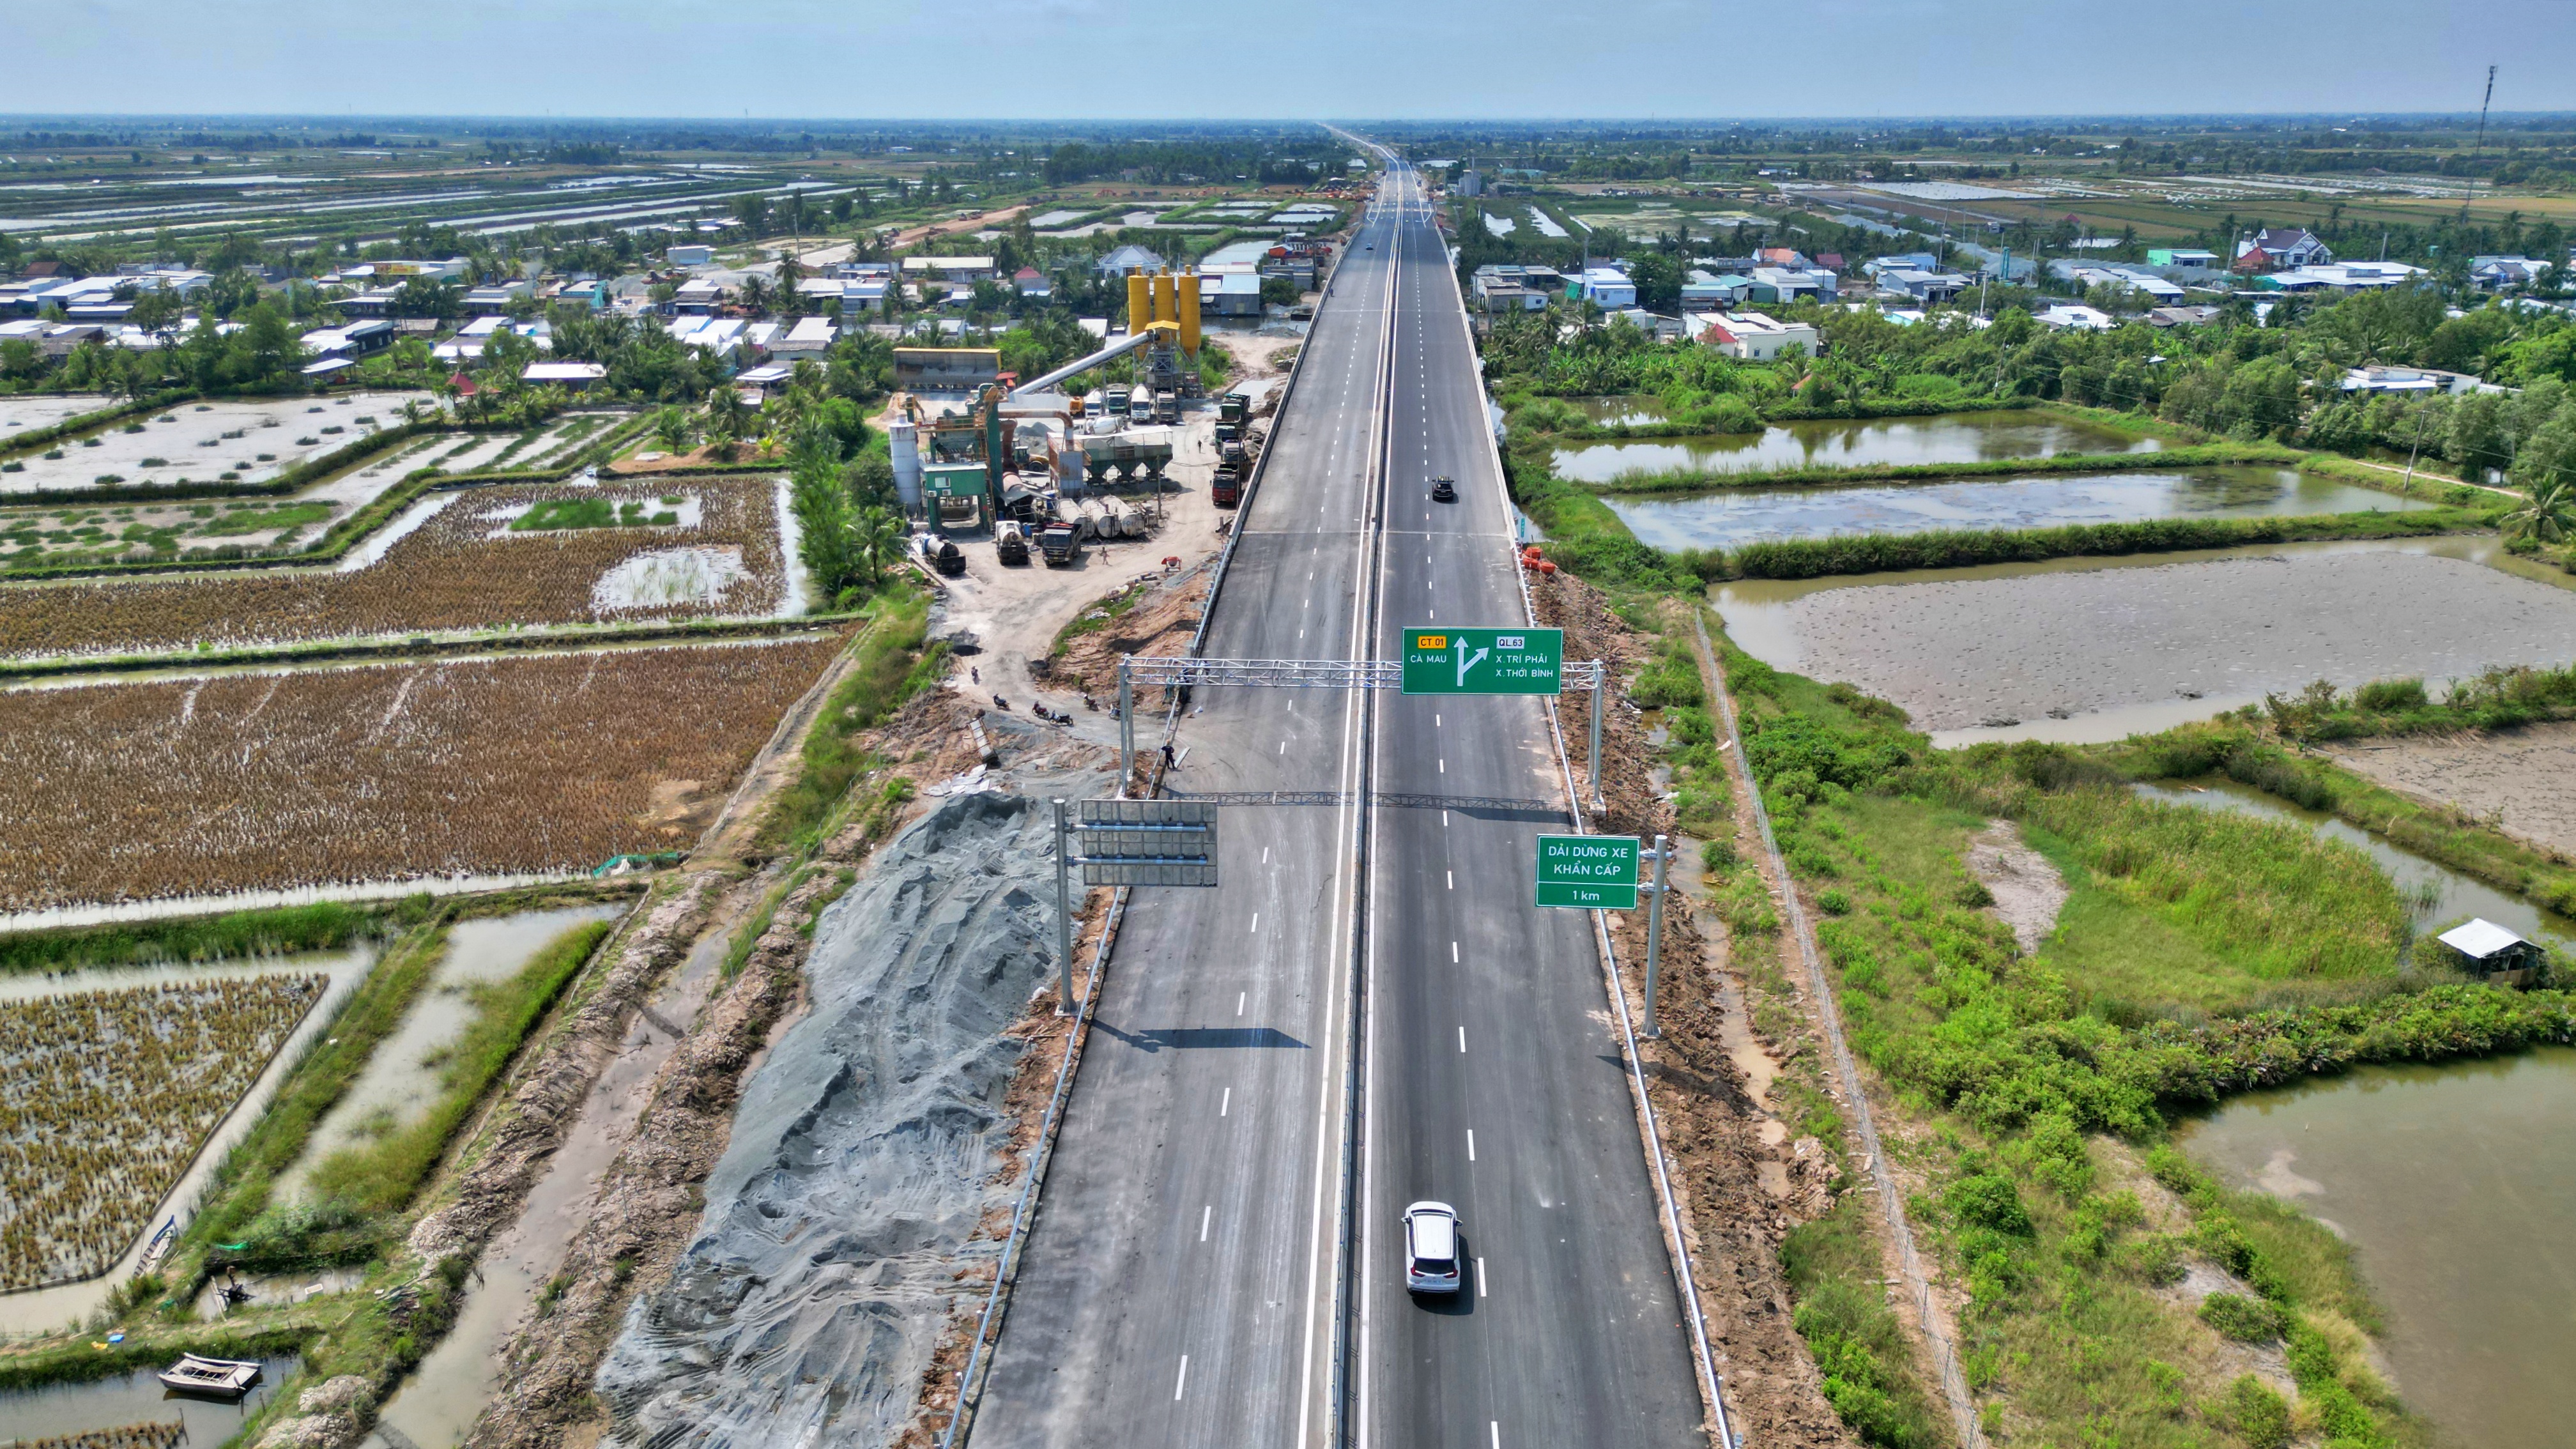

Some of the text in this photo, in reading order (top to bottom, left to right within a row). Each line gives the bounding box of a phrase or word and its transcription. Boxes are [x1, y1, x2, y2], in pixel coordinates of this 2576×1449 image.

[1410, 652, 1446, 663] CÀ MAU
[1525, 653, 1547, 663] PHẢI
[1531, 668, 1553, 677] BÌNH
[1548, 843, 1629, 858] DẢI DỪNG XE
[1554, 860, 1621, 875] KHẨN CẤP
[1572, 890, 1600, 901] 1 km
